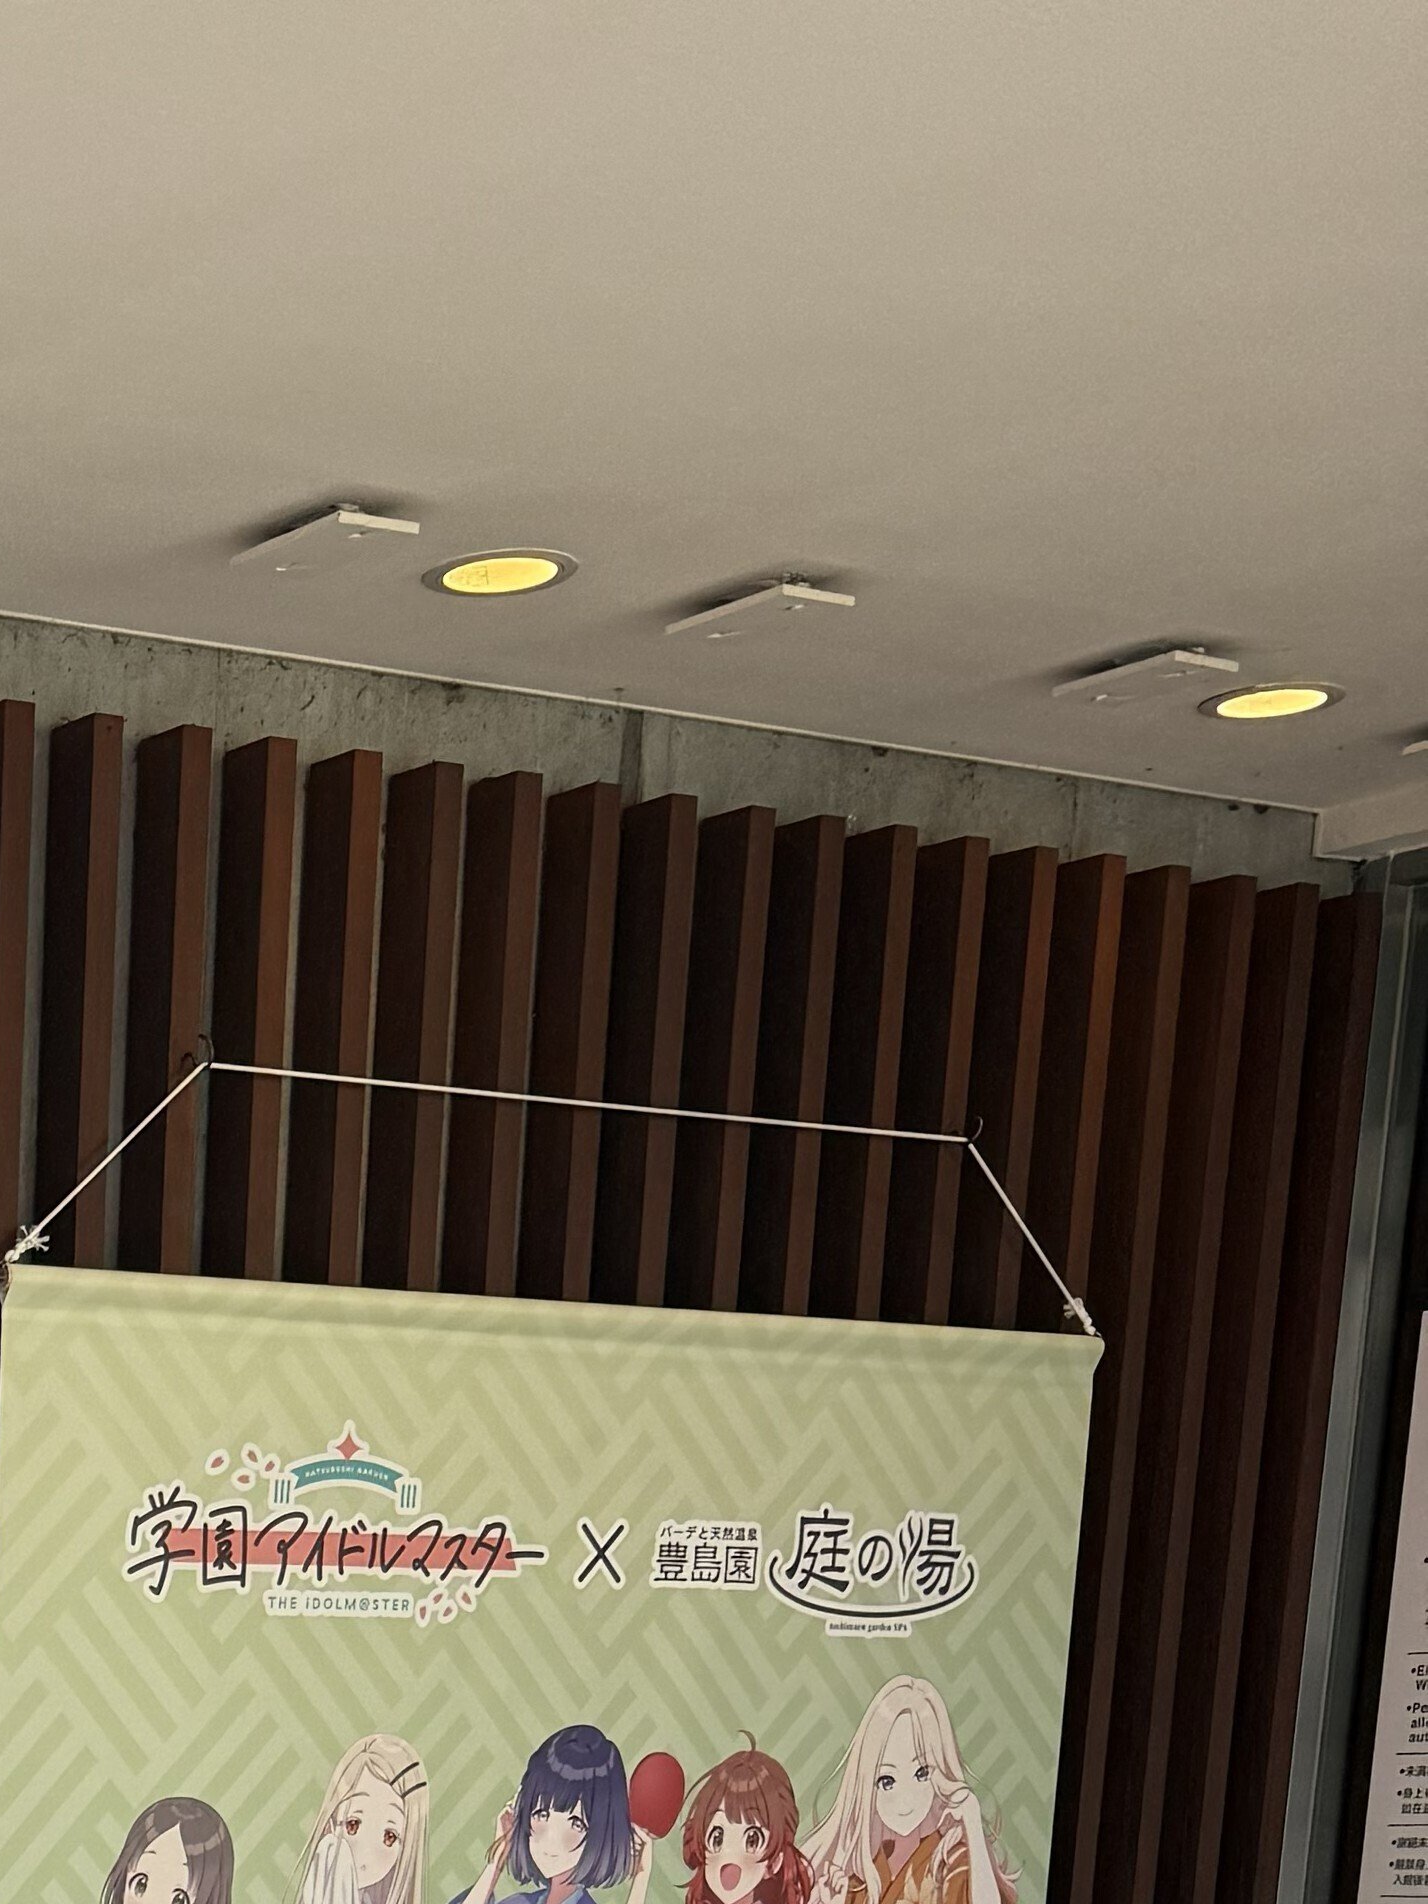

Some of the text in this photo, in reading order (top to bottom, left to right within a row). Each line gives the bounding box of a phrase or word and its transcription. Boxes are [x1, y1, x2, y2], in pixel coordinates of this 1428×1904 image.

[127, 1485, 546, 1595] 学園アイドルマスター
[653, 1508, 962, 1598] 豊島園 庭の湯
[660, 1526, 759, 1541] バーデと天然温泉
[268, 1595, 298, 1611] THE
